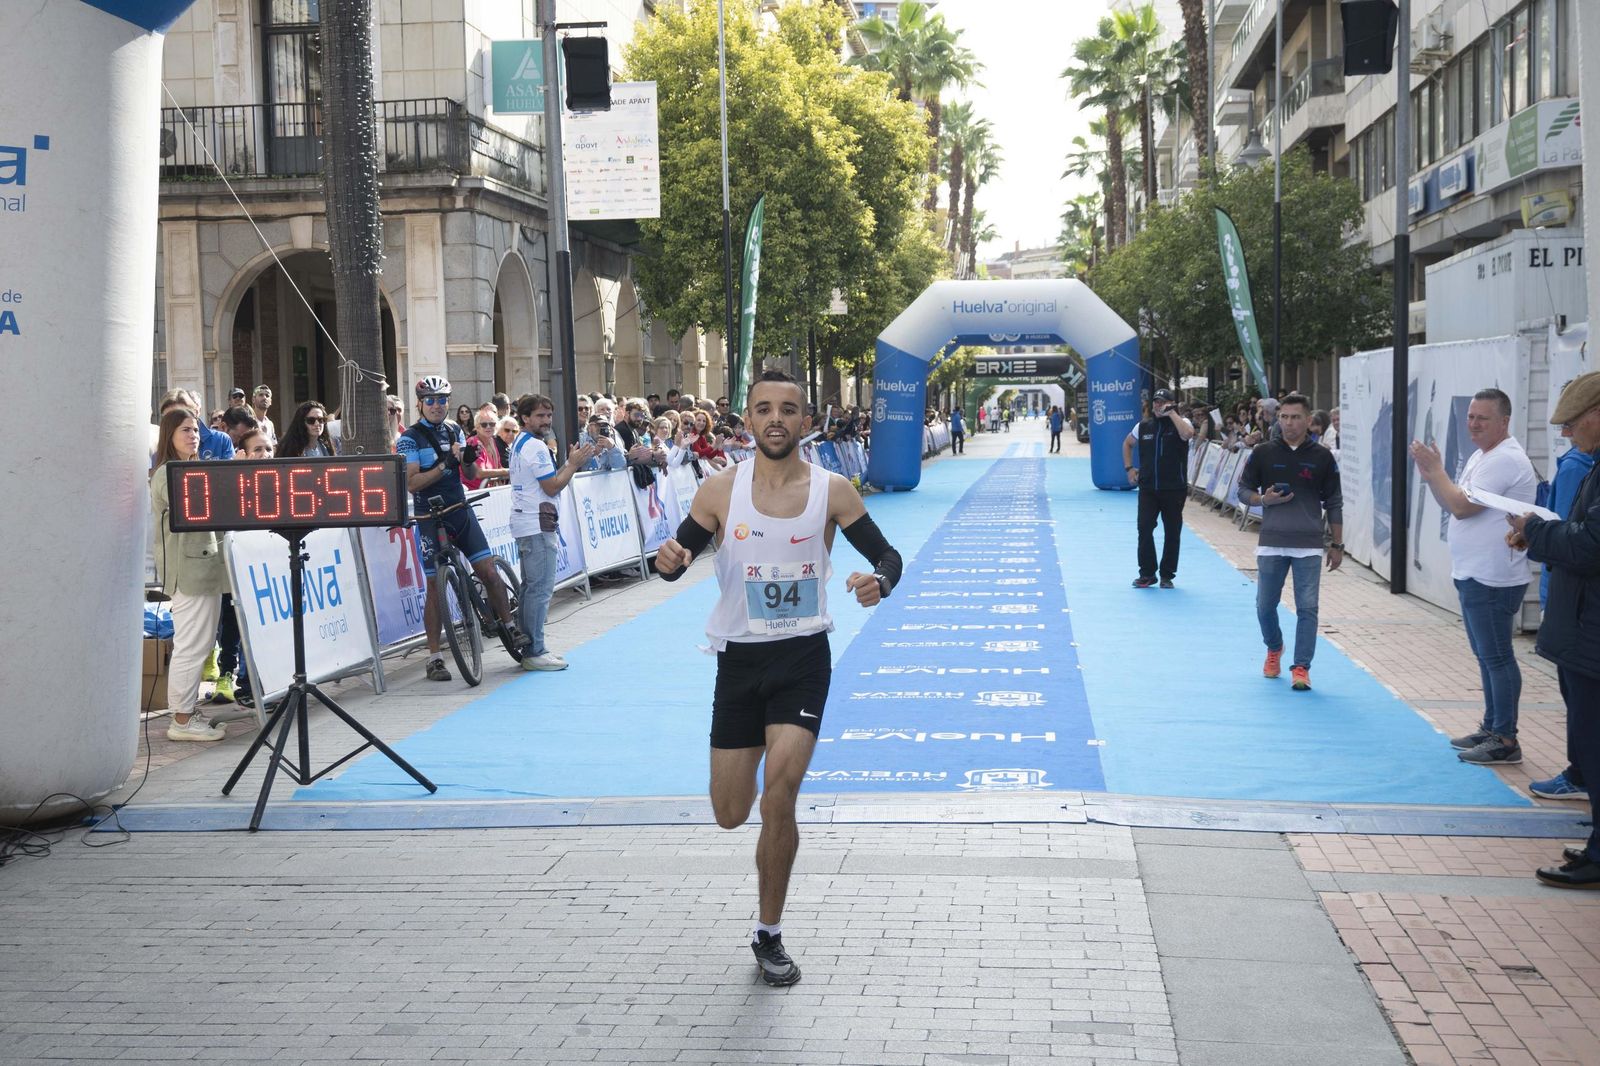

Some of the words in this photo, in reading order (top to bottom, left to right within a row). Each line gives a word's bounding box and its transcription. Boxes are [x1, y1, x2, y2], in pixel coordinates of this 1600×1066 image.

[575, 142, 598, 151] apavt
[1543, 151, 1558, 163] La
[1563, 147, 1583, 161] Pa
[1529, 248, 1553, 267] EL
[953, 300, 1003, 313] Huelva
[1008, 299, 1057, 316] original
[876, 379, 916, 393] Huelva
[1091, 379, 1133, 393] Huelva
[1107, 413, 1134, 422] HUELVA
[184, 472, 210, 520] 0
[598, 513, 631, 539] HUELVA
[751, 530, 764, 538] NN
[764, 582, 801, 609] 94
[319, 613, 349, 642] original
[876, 667, 1050, 675] Huelva
[840, 731, 1056, 743] Huelva
[805, 770, 948, 778] HUELVA
